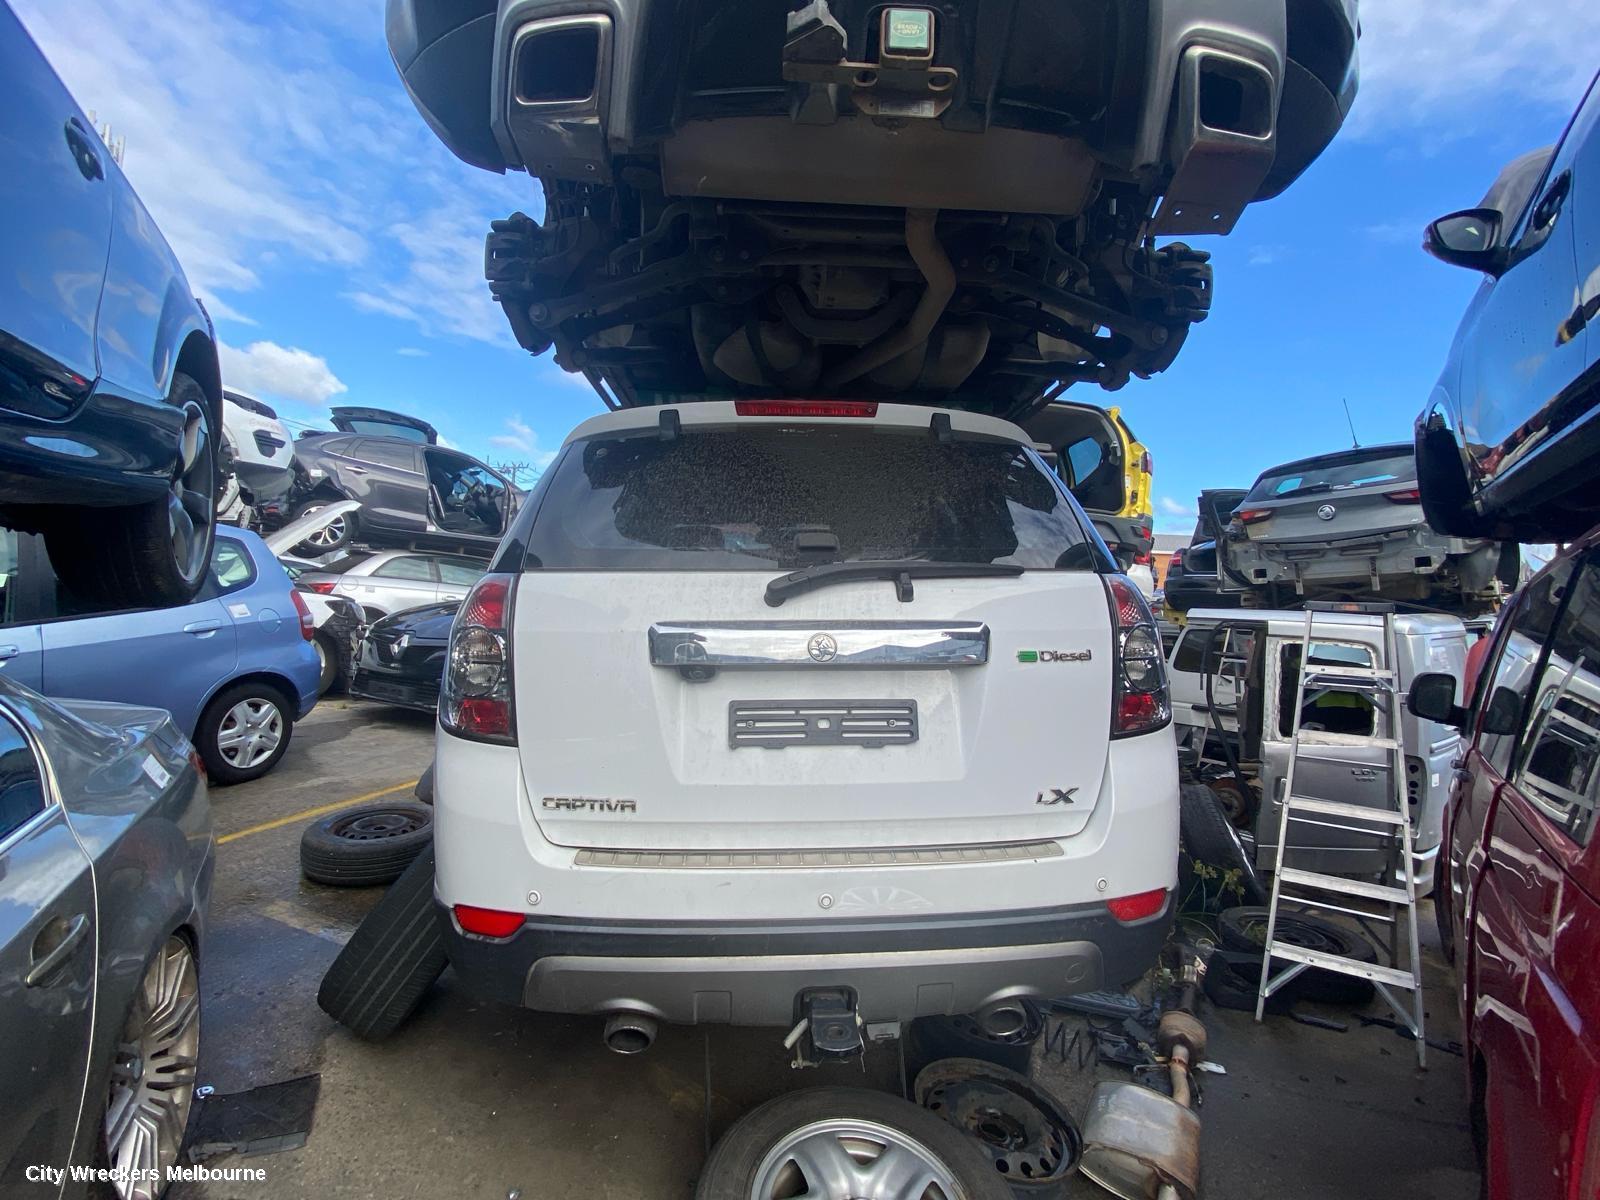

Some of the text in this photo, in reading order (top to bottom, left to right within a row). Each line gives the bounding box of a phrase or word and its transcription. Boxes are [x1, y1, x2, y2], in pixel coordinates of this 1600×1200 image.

[1039, 649, 1092, 662] Diesel
[1035, 787, 1080, 805] LX
[542, 797, 637, 813] CAPTIVA
